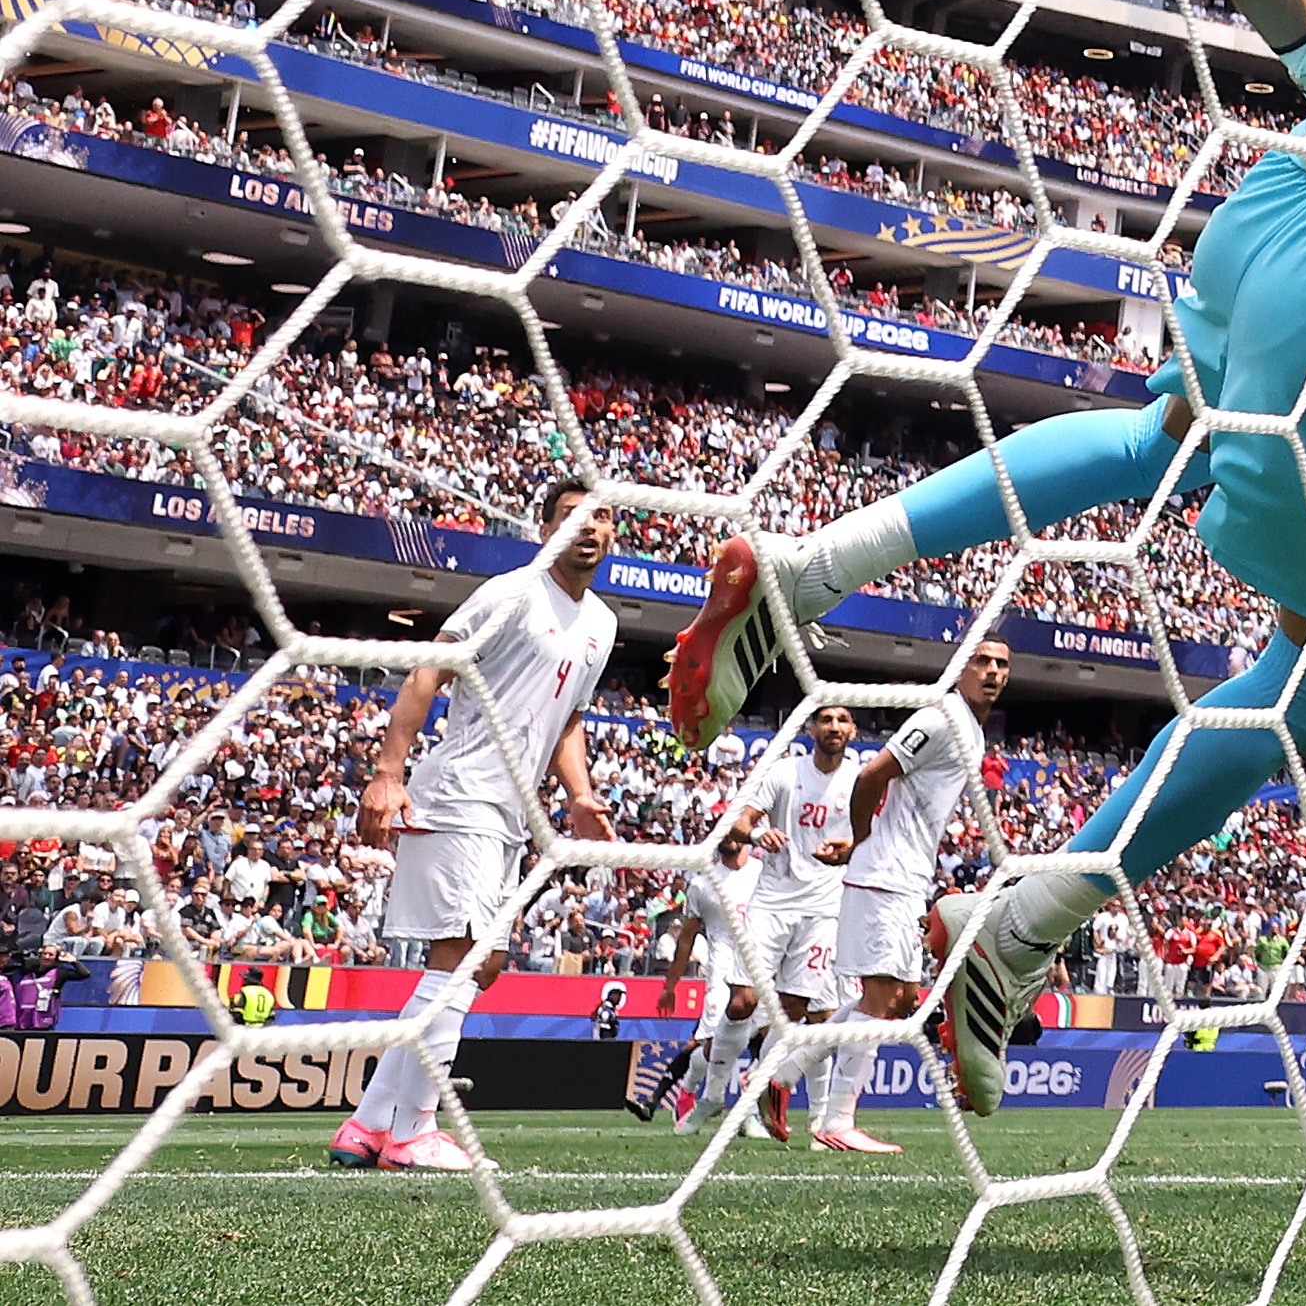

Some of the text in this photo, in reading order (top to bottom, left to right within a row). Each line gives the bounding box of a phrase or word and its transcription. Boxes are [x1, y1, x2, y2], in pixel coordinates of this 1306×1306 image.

[680, 59, 818, 110] FIFA WORLD CUP 2026
[1076, 167, 1158, 196] LOS ANGELES
[230, 174, 395, 232] LOS ANELES
[718, 286, 929, 352] FIFA WORLD UP 2026
[152, 493, 316, 538] LOS AGELES
[609, 562, 650, 589] FIFA
[1054, 629, 1157, 660] LOS ANGELE
[554, 658, 573, 699] 4
[799, 802, 828, 829] 20
[807, 946, 832, 970] 20
[135, 1040, 388, 1110] PASSIO
[1003, 1060, 1072, 1095] 026
